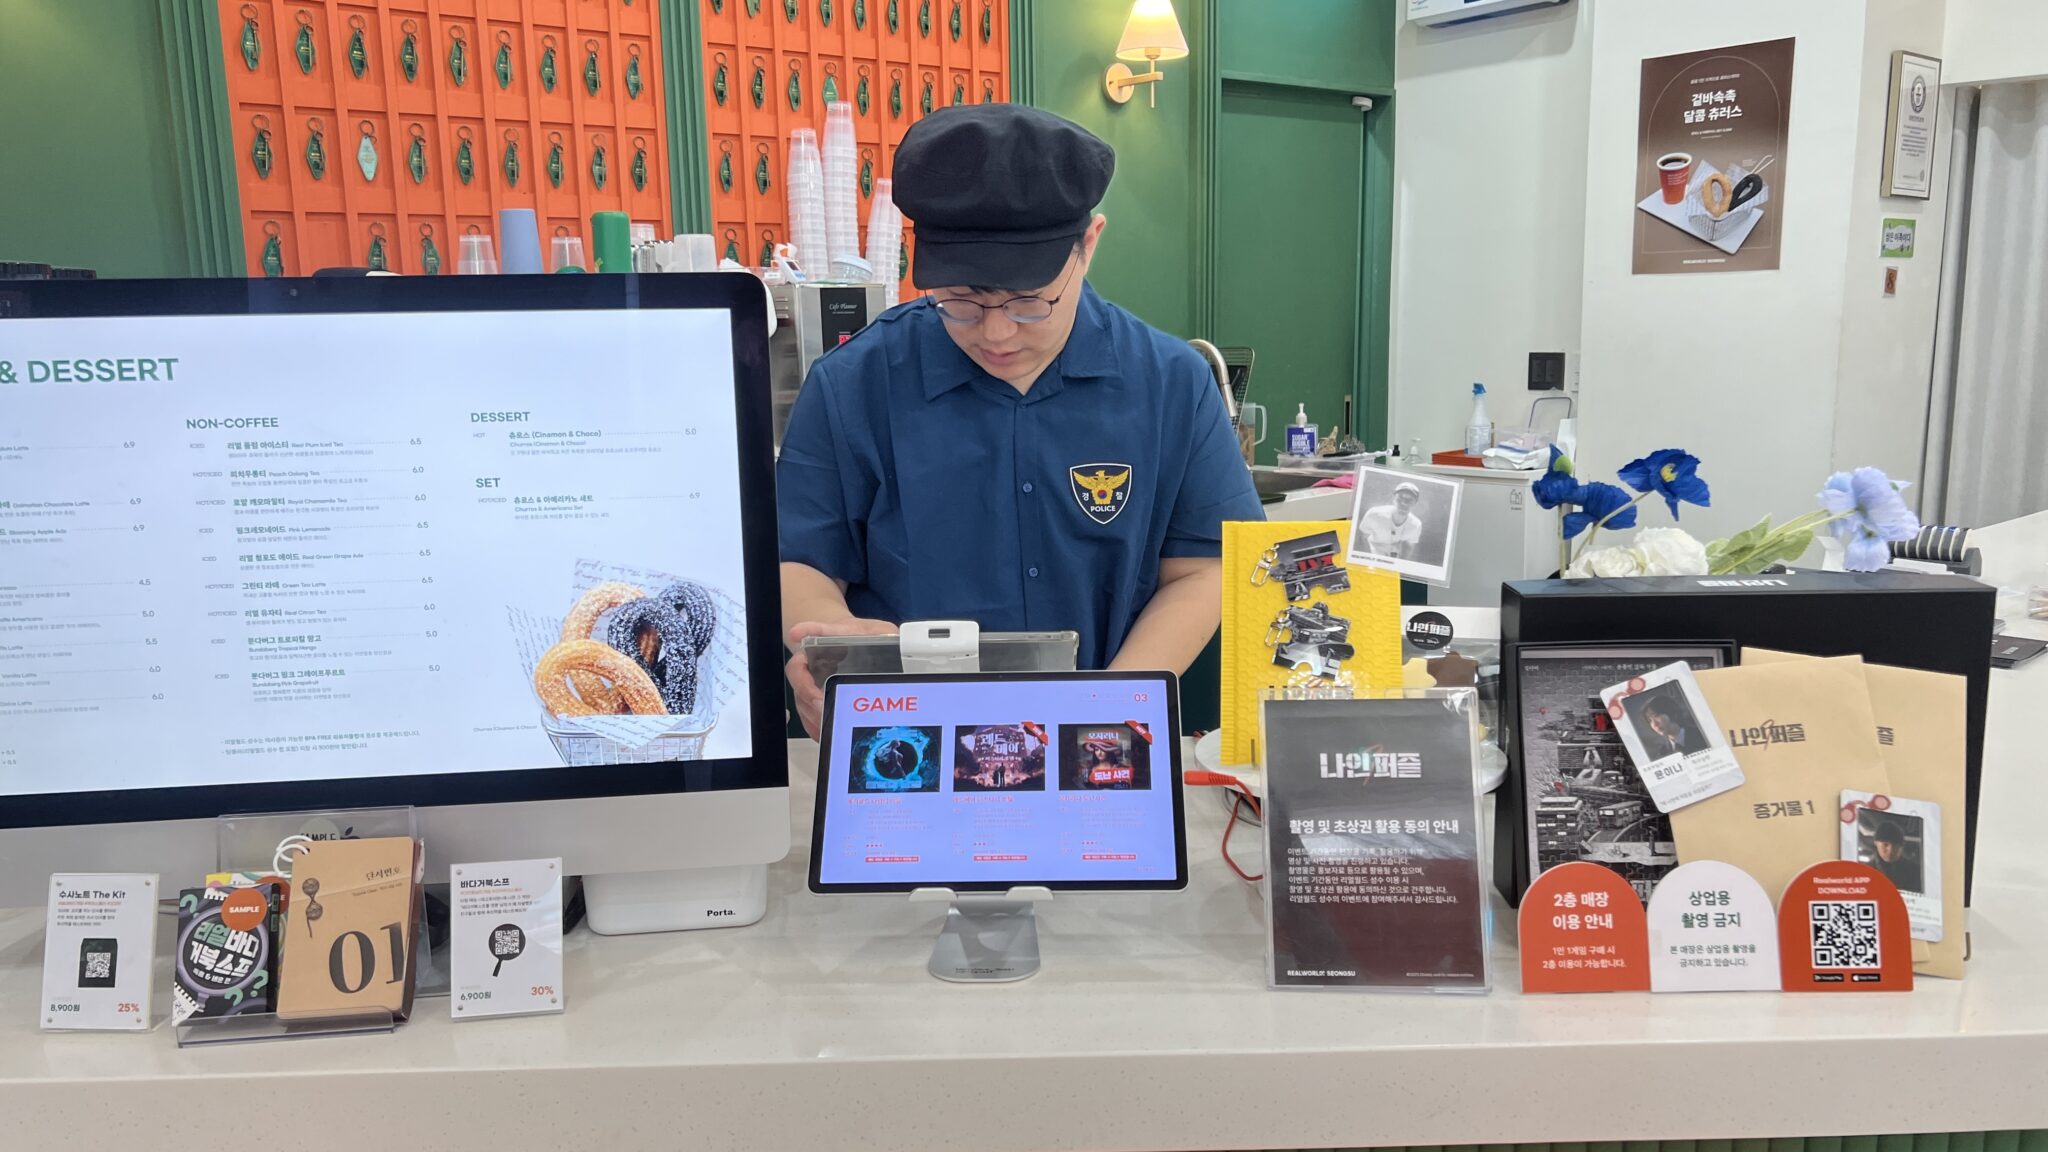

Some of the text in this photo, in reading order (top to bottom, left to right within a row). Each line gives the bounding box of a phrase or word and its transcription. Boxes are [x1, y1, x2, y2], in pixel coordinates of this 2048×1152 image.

[1684, 105, 1743, 124] 달콤 츄러스
[0, 358, 179, 384] & DESSERT
[470, 411, 531, 423] DESSERT
[186, 417, 279, 429] NON-COFFEE
[575, 429, 602, 438] Choco)
[123, 441, 136, 449] 6.9
[259, 440, 289, 450] 아이스티
[409, 438, 422, 446] 6.5
[412, 466, 424, 474] 6.0
[476, 478, 501, 489] SET
[414, 493, 426, 501] 6.0
[689, 492, 701, 500] 6.9
[1090, 505, 1116, 513] POLICE
[133, 524, 145, 532] 6.9
[417, 521, 429, 529] 6.5
[419, 549, 431, 557] 6.5
[423, 603, 436, 611] 6.0
[142, 610, 155, 618] 5.0
[425, 630, 438, 638] 5.0
[145, 638, 158, 646] 5.5
[149, 665, 161, 673] 6.0
[428, 664, 440, 672] 5.0
[152, 693, 164, 701] 6.0
[1134, 693, 1149, 703] 03
[853, 696, 919, 713] GAME
[1319, 752, 1422, 780] 나인퍼즐
[1753, 800, 1815, 819] 증거물 1
[1289, 819, 1460, 834] 촬영 및 초상권 활용 동의 안내
[1379, 857, 1411, 866] 있습니다.
[1392, 867, 1399, 876] 수
[1400, 866, 1425, 877] 있으며,
[460, 877, 510, 889] 바다거북스프
[1385, 876, 1400, 885] 이용
[1401, 876, 1409, 885] 시
[1853, 876, 1872, 884] APP
[59, 890, 127, 900] 수사노트 The Kit
[1388, 886, 1410, 895] 것으로
[1817, 886, 1868, 895] DOWNLOAD
[1553, 892, 1610, 908] 2층 매장
[1688, 891, 1731, 907] 상업용
[228, 905, 261, 914] SAMPLE
[707, 909, 737, 918] Porta.
[1552, 913, 1615, 930] 이용 안내
[1681, 912, 1742, 929] 촬영 금지
[1552, 946, 1566, 956] 1인
[1589, 946, 1606, 956] 구매
[1607, 945, 1616, 955] 시
[1670, 945, 1678, 955] 본
[1679, 945, 1704, 956] 매장은
[1706, 945, 1731, 955] 상업용
[328, 922, 408, 994] 01
[1679, 958, 1749, 968] 금지하고 있습니다.
[1542, 959, 1628, 970] 2층 이용이 가능합니다.
[531, 986, 554, 997] 30%
[460, 992, 492, 1002] 6,900원
[50, 1003, 81, 1013] 8,900원
[117, 1003, 140, 1013] 25%
